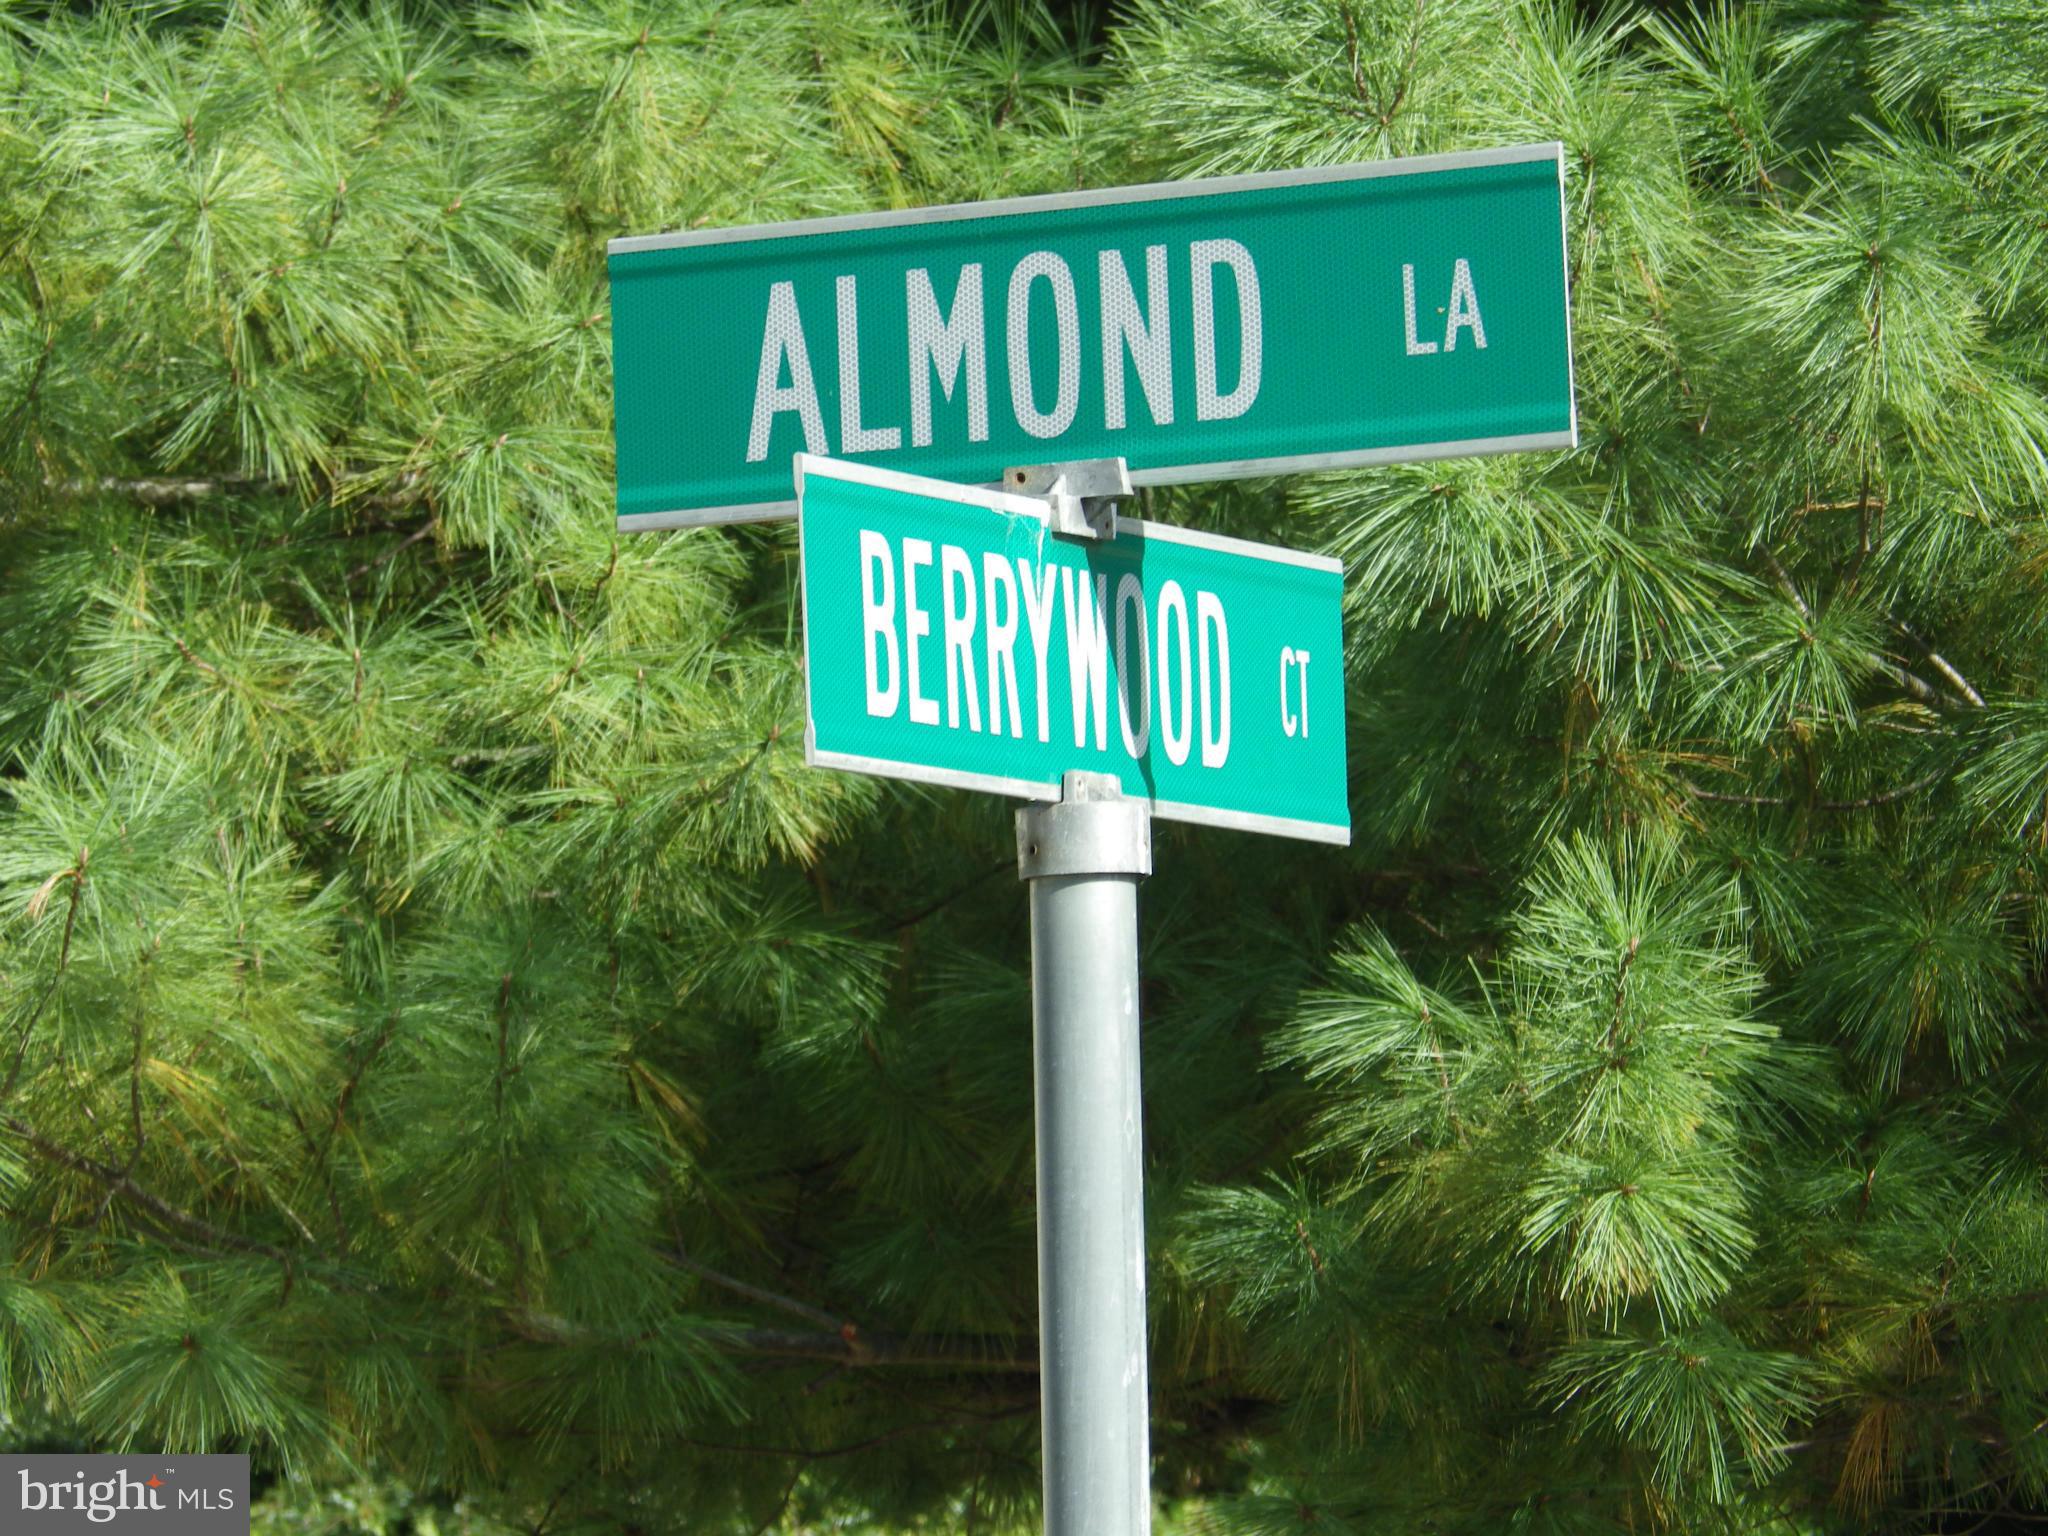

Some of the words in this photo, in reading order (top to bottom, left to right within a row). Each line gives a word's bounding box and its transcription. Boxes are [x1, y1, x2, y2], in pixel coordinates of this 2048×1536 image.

[746, 238, 1262, 463] ALMOND
[1402, 258, 1488, 356] LA
[860, 529, 1231, 769] BERRYWOOD
[1280, 646, 1310, 739] CT
